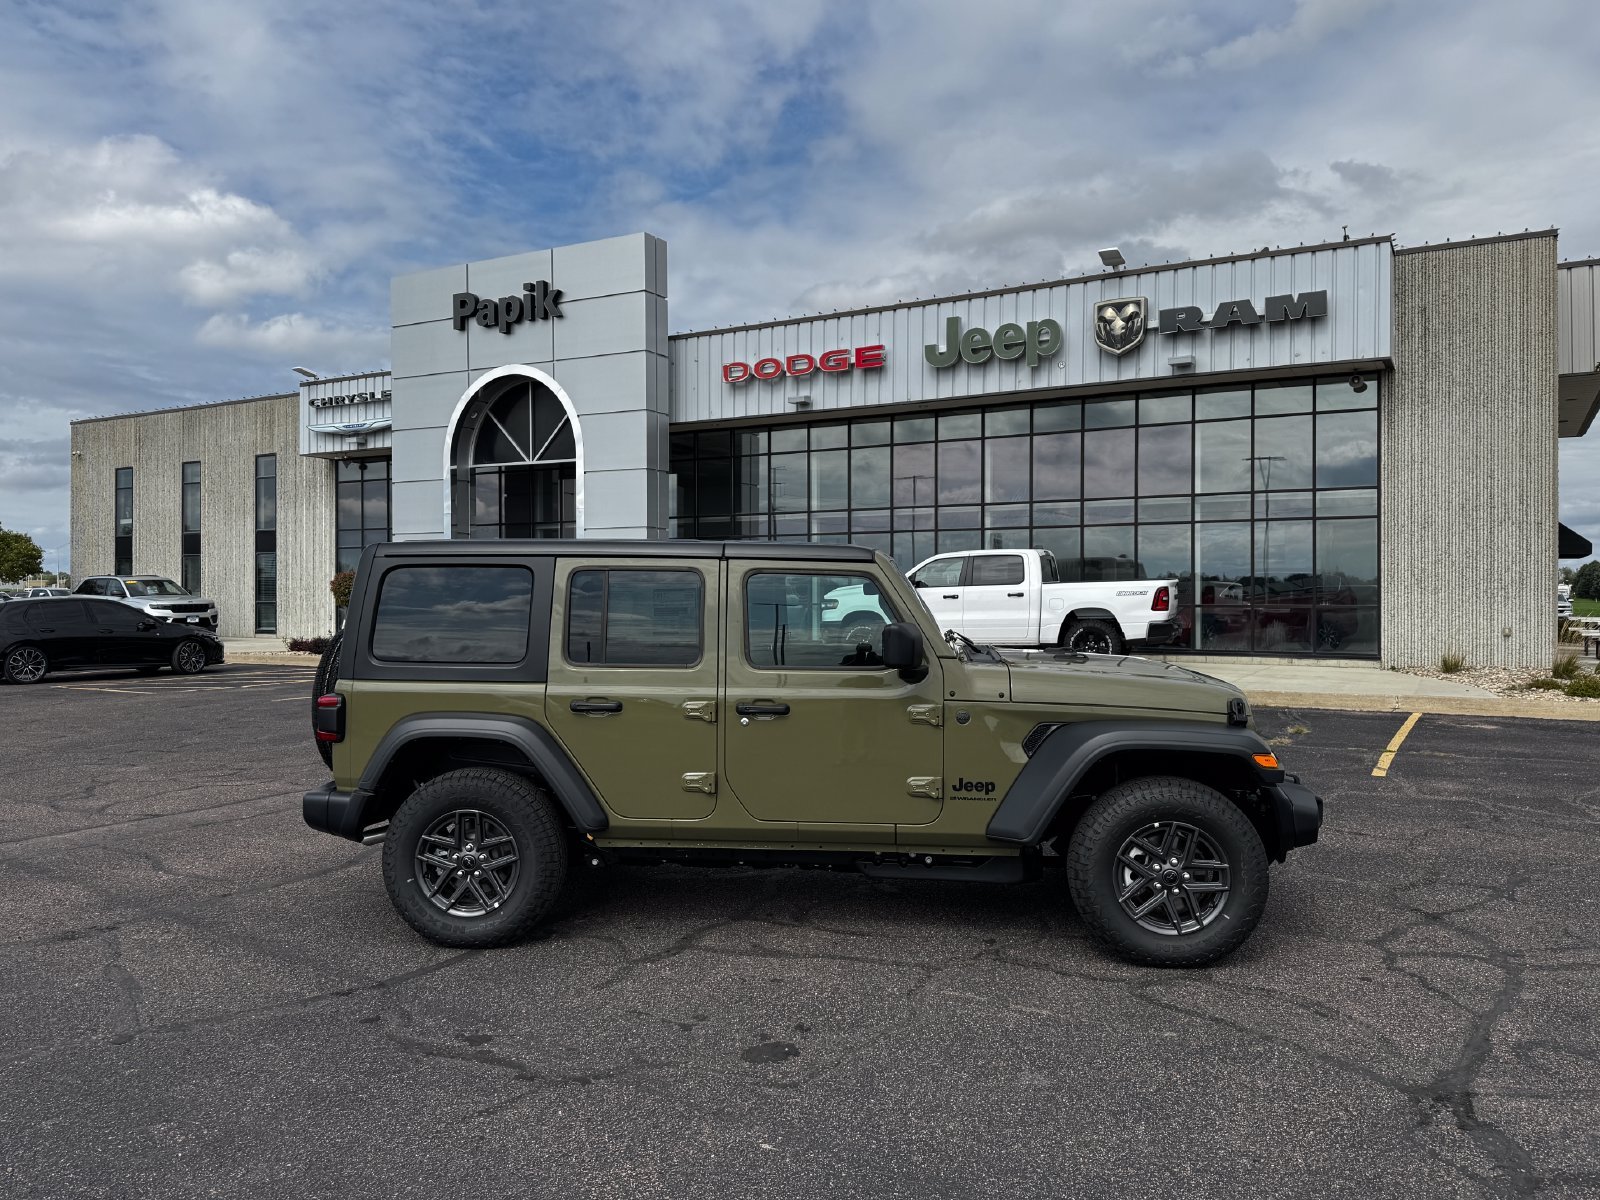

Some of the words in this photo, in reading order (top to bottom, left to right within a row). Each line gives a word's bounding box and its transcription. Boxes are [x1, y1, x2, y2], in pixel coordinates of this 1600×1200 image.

[453, 280, 564, 334] Papik
[1159, 289, 1328, 335] RAM
[722, 344, 887, 383] DODGE
[924, 316, 1063, 368] Jeep
[951, 777, 996, 796] Jeep
